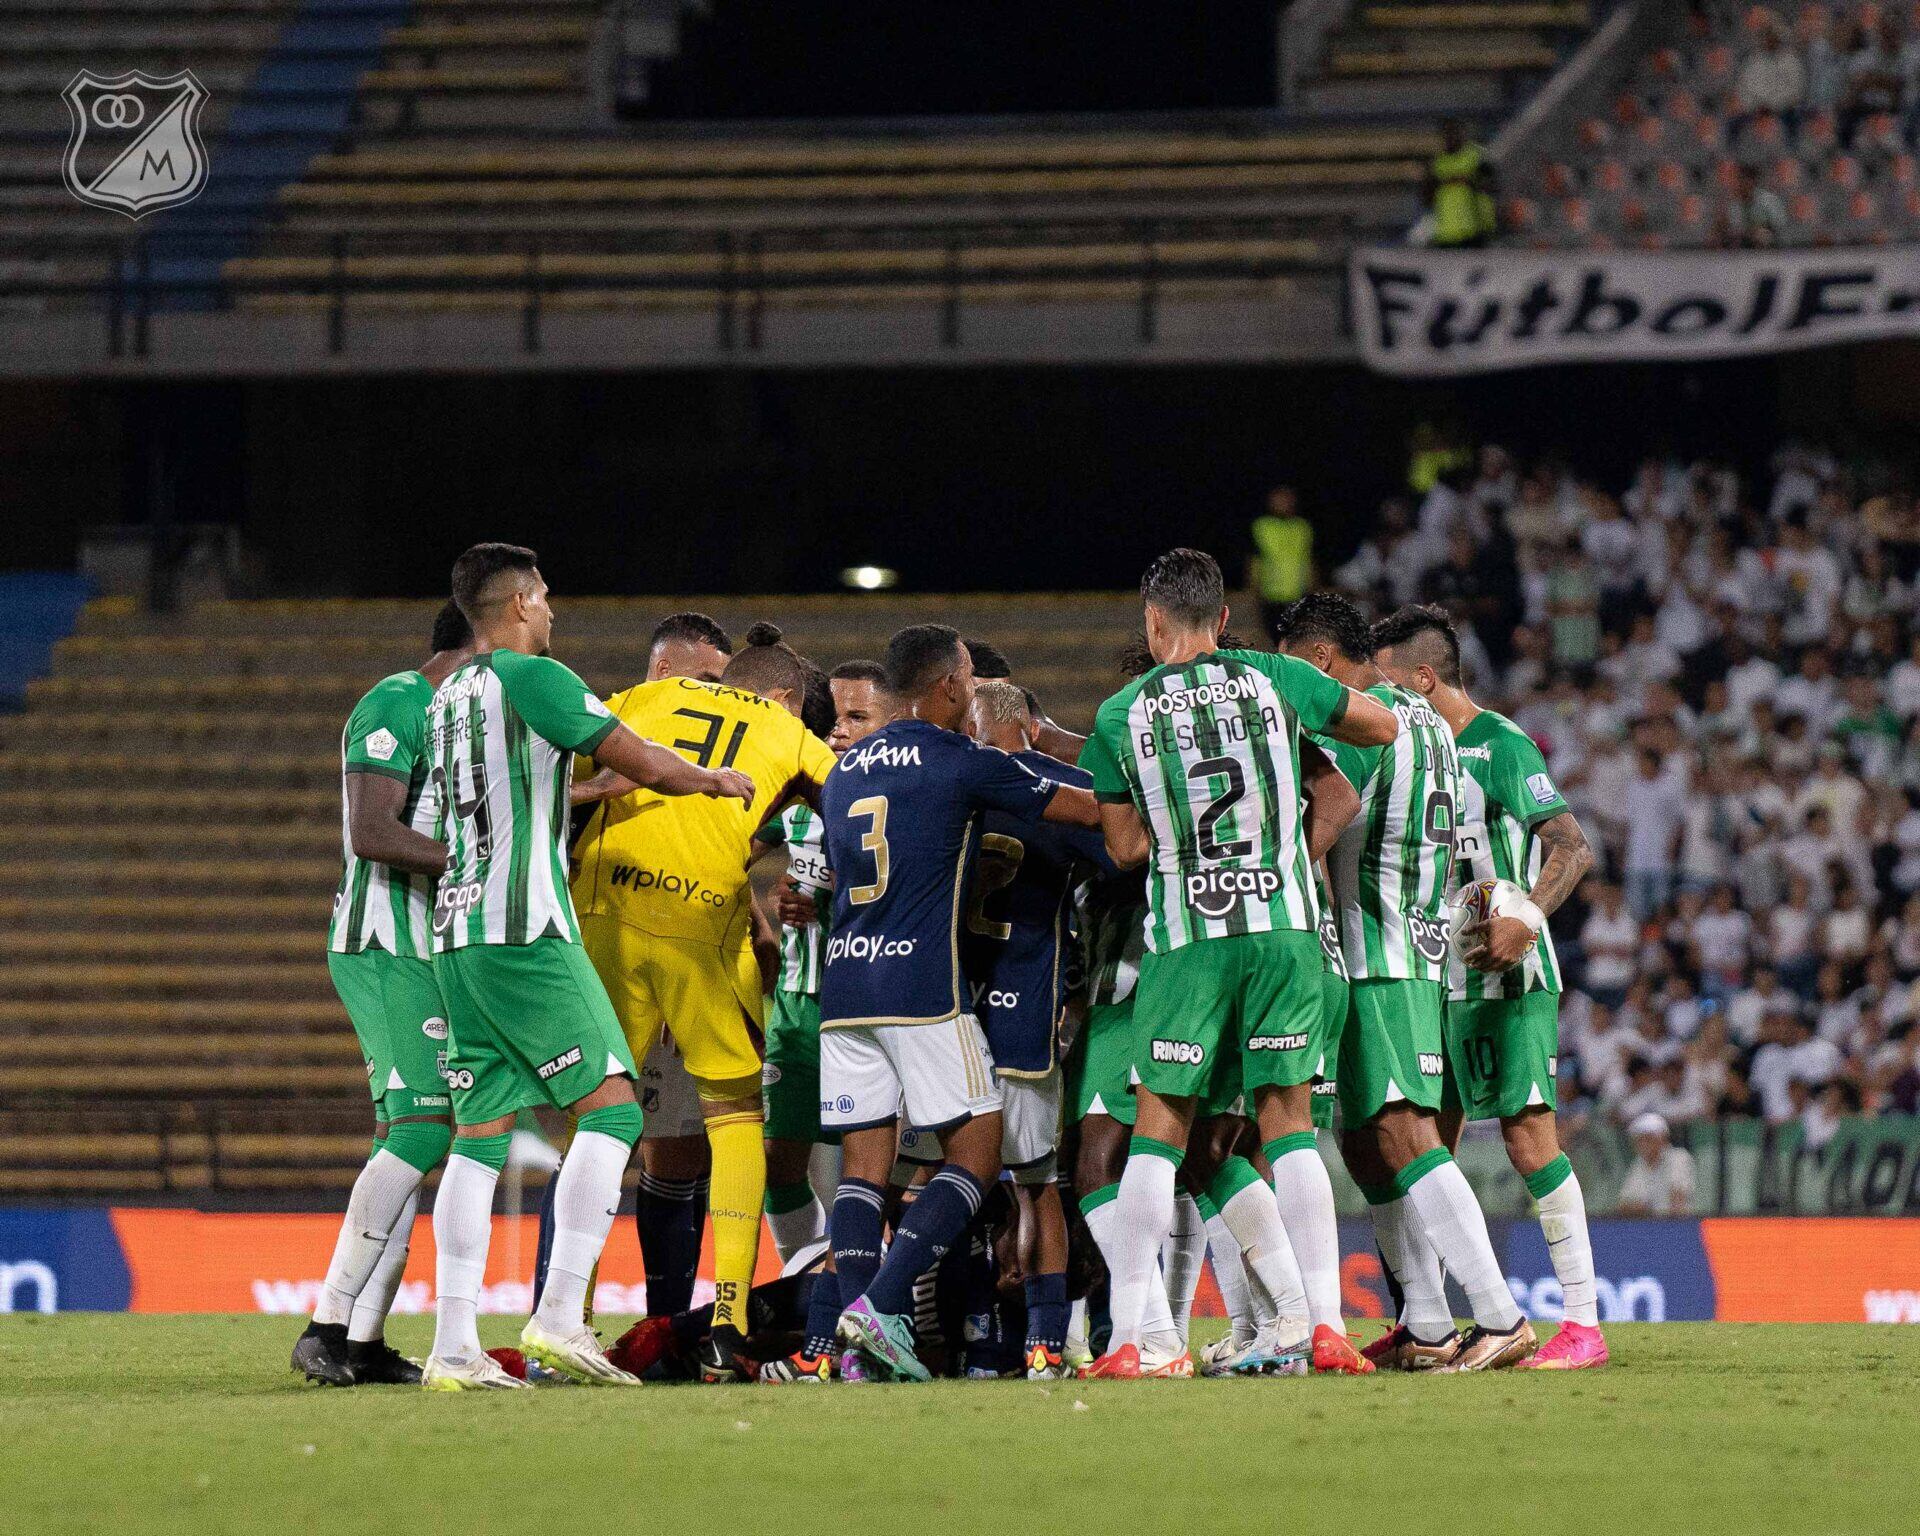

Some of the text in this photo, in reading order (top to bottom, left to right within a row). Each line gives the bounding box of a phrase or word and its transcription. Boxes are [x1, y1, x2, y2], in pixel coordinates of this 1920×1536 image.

[1144, 673, 1258, 724] POSTOBON
[1188, 756, 1253, 860] 2
[847, 795, 890, 905] 3
[790, 857, 832, 882] ets
[1186, 867, 1279, 905] picap
[425, 1023, 447, 1033] ARES
[1248, 1033, 1308, 1050] SPORTLINE
[1152, 1040, 1204, 1064] RINGO
